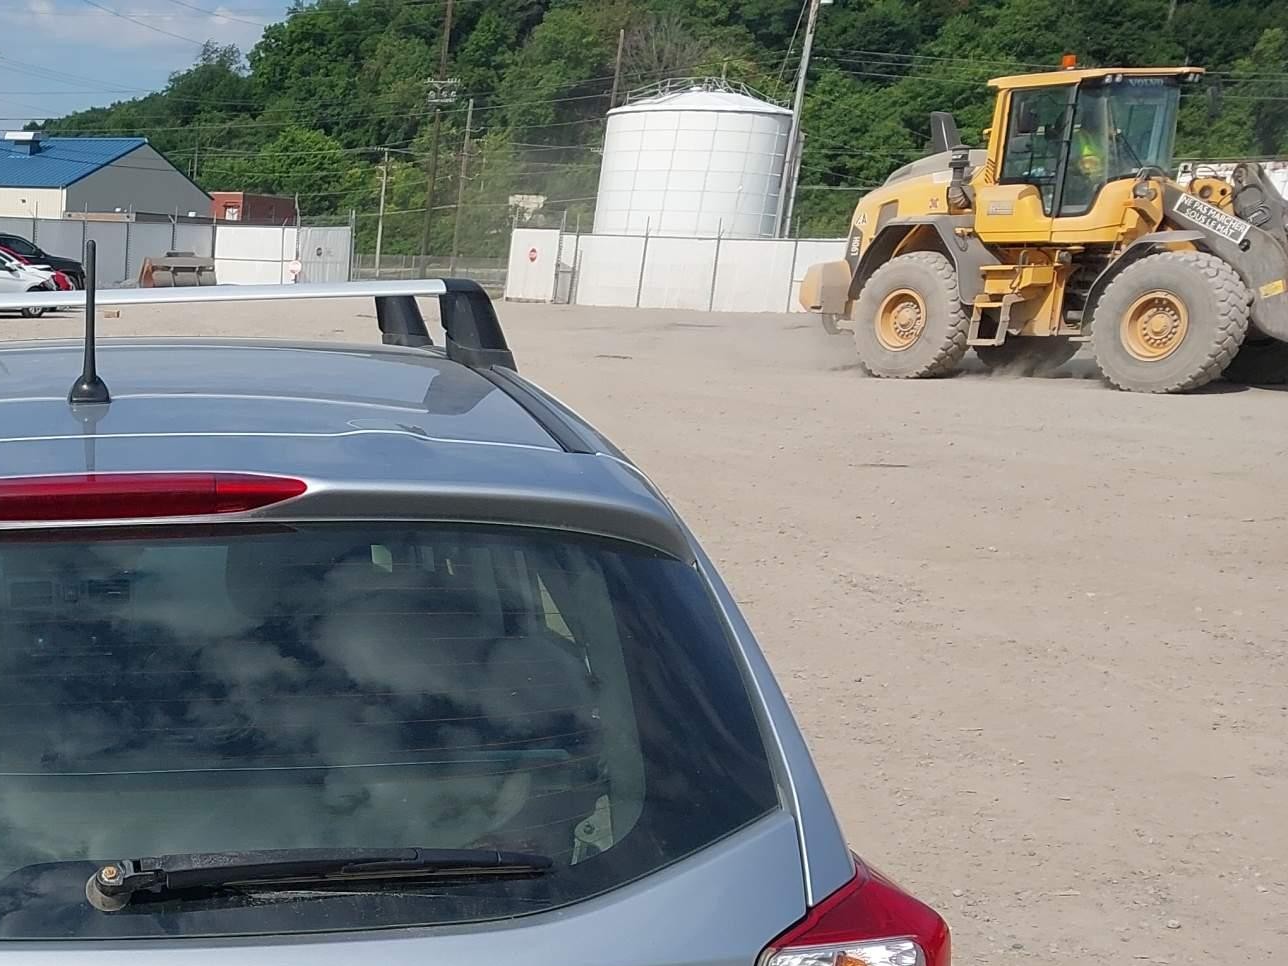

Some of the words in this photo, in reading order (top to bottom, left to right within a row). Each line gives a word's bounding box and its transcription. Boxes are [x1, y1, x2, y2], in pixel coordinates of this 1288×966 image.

[1128, 79, 1164, 87] VOLVO
[1183, 196, 1193, 206] NE
[1193, 201, 1208, 214] PAS
[1207, 208, 1246, 233] MARCHER
[1185, 208, 1206, 225] SOUS
[1205, 219, 1217, 229] LE
